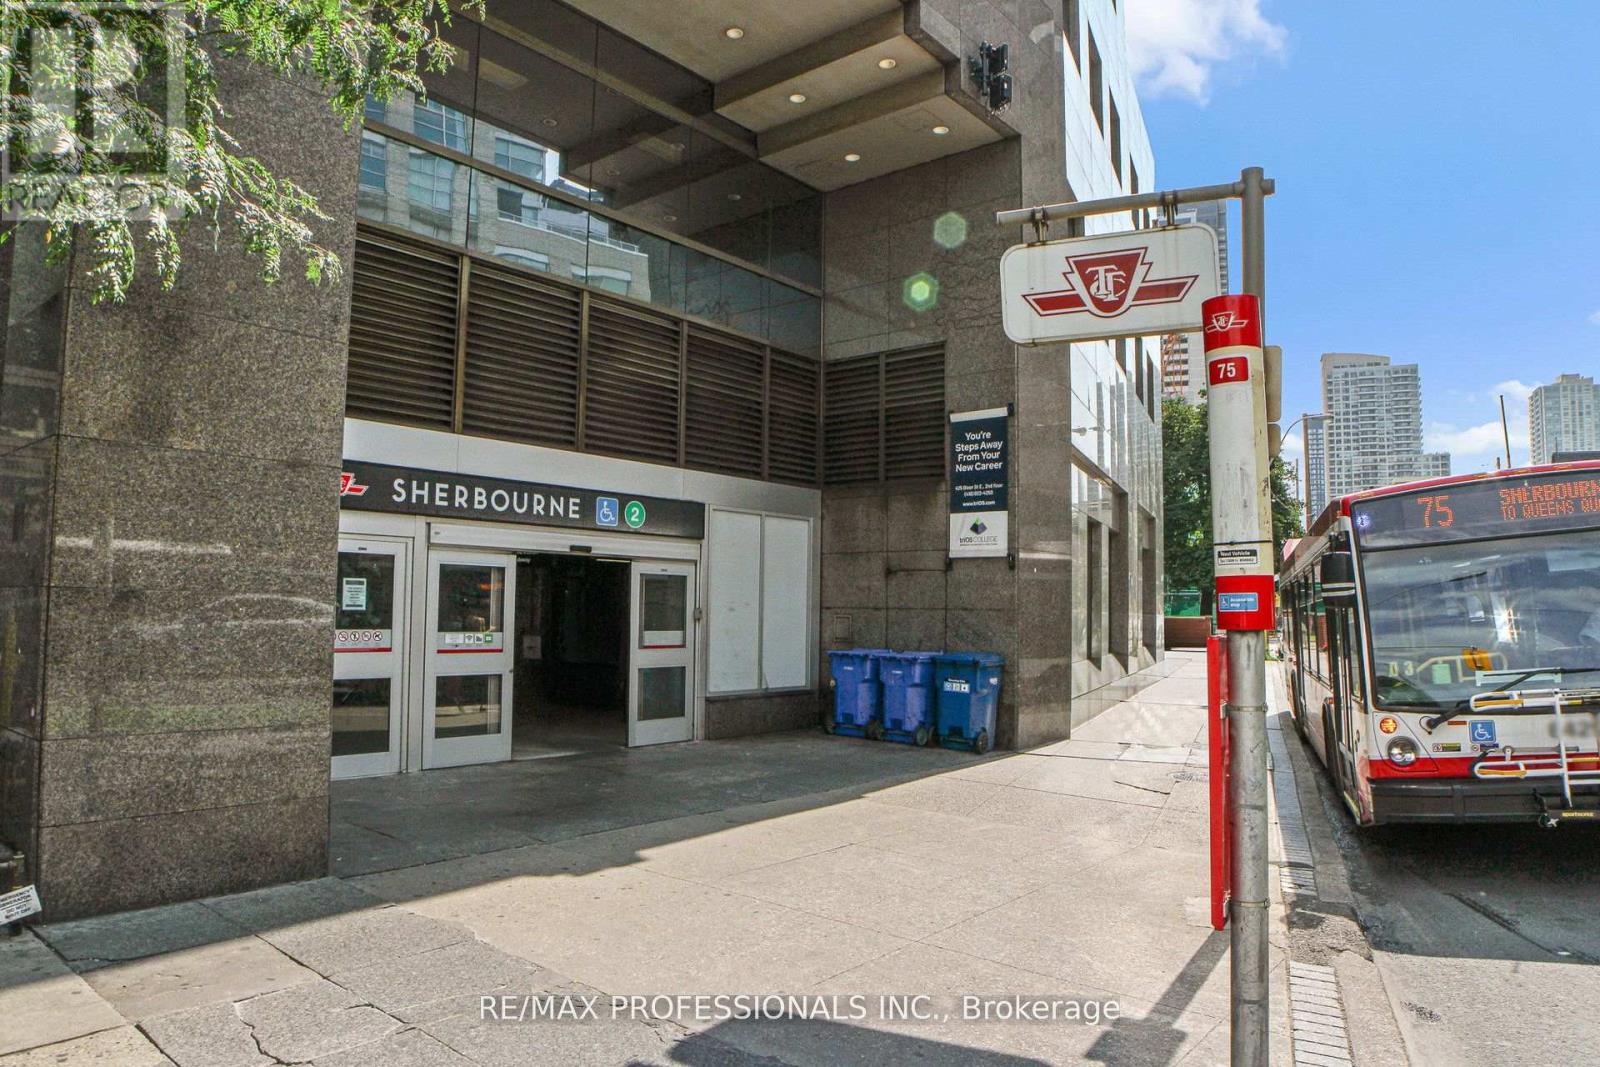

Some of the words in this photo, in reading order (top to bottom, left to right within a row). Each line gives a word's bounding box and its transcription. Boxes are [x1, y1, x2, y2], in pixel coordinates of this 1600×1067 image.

[1217, 362, 1236, 379] 75
[965, 431, 991, 440] You're
[955, 442, 979, 452] Steps
[980, 441, 1003, 450] Away
[958, 453, 980, 462] From
[981, 451, 1000, 460] Your
[955, 463, 973, 472] New
[974, 462, 1003, 470] Career
[392, 477, 581, 519] SHERBOURNE
[629, 507, 640, 522] 2
[1417, 495, 1455, 528] 75
[1501, 504, 1516, 520] TO
[1522, 499, 1575, 519] QUEENS
